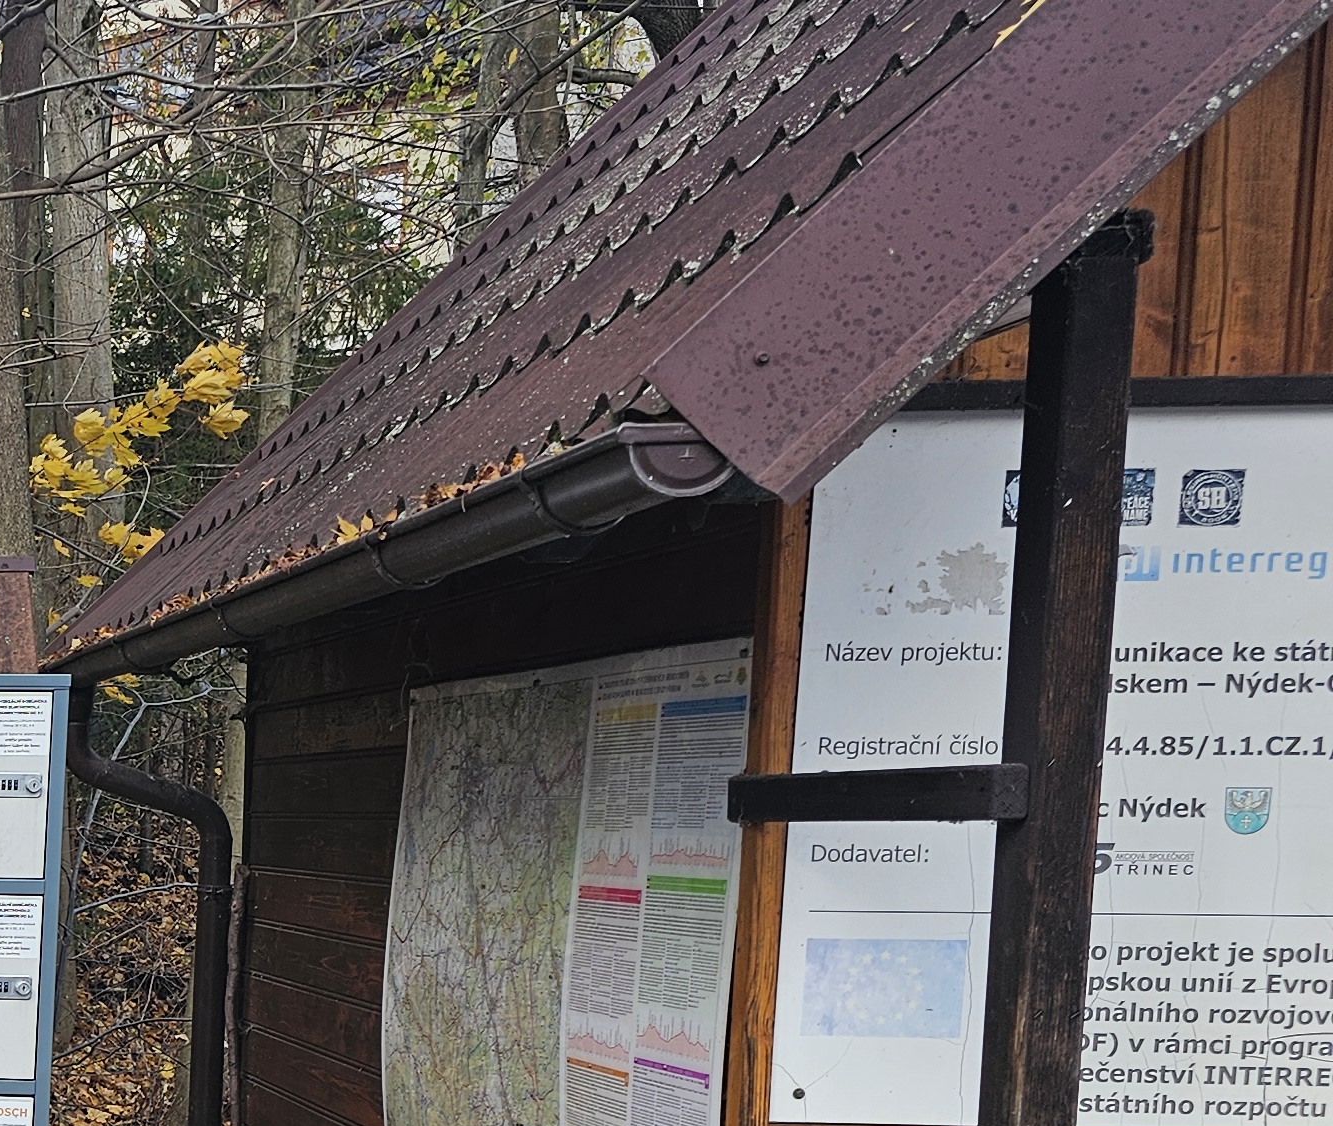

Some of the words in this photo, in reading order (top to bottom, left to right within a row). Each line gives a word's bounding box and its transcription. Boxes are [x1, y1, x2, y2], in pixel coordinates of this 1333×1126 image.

[1197, 486, 1227, 510] SB
[1171, 547, 1328, 580] interreg
[825, 641, 894, 662] Název
[900, 642, 1003, 667] projektu:
[1114, 641, 1224, 663] unikace
[1232, 642, 1266, 662] ke
[1273, 639, 1333, 662] stát
[1107, 673, 1189, 694] lskem
[818, 733, 943, 760] Registrační
[949, 733, 999, 756] číslo
[1105, 734, 1333, 761] 4.4.85/1.1.CZ.1
[1118, 795, 1208, 823] Nýdek
[811, 843, 929, 863] Dodavatel:
[1114, 860, 1194, 876] TŘINEC
[1116, 941, 1220, 966] projekt
[1224, 942, 1254, 967] je
[1087, 972, 1171, 996] pskou
[1181, 971, 1235, 993] unií
[1240, 978, 1257, 994] z
[1265, 974, 1333, 1000] Evro
[1082, 1001, 1199, 1024] onálního
[1207, 1005, 1333, 1030] rozvojov
[1128, 1037, 1145, 1053] v
[1153, 1032, 1232, 1055] rámci
[1240, 1038, 1333, 1060] progra
[1079, 1061, 1196, 1084] ečenství
[1203, 1065, 1333, 1087] INTERRE
[1078, 1092, 1195, 1114] státního
[1203, 1095, 1328, 1121] rozpočtu
